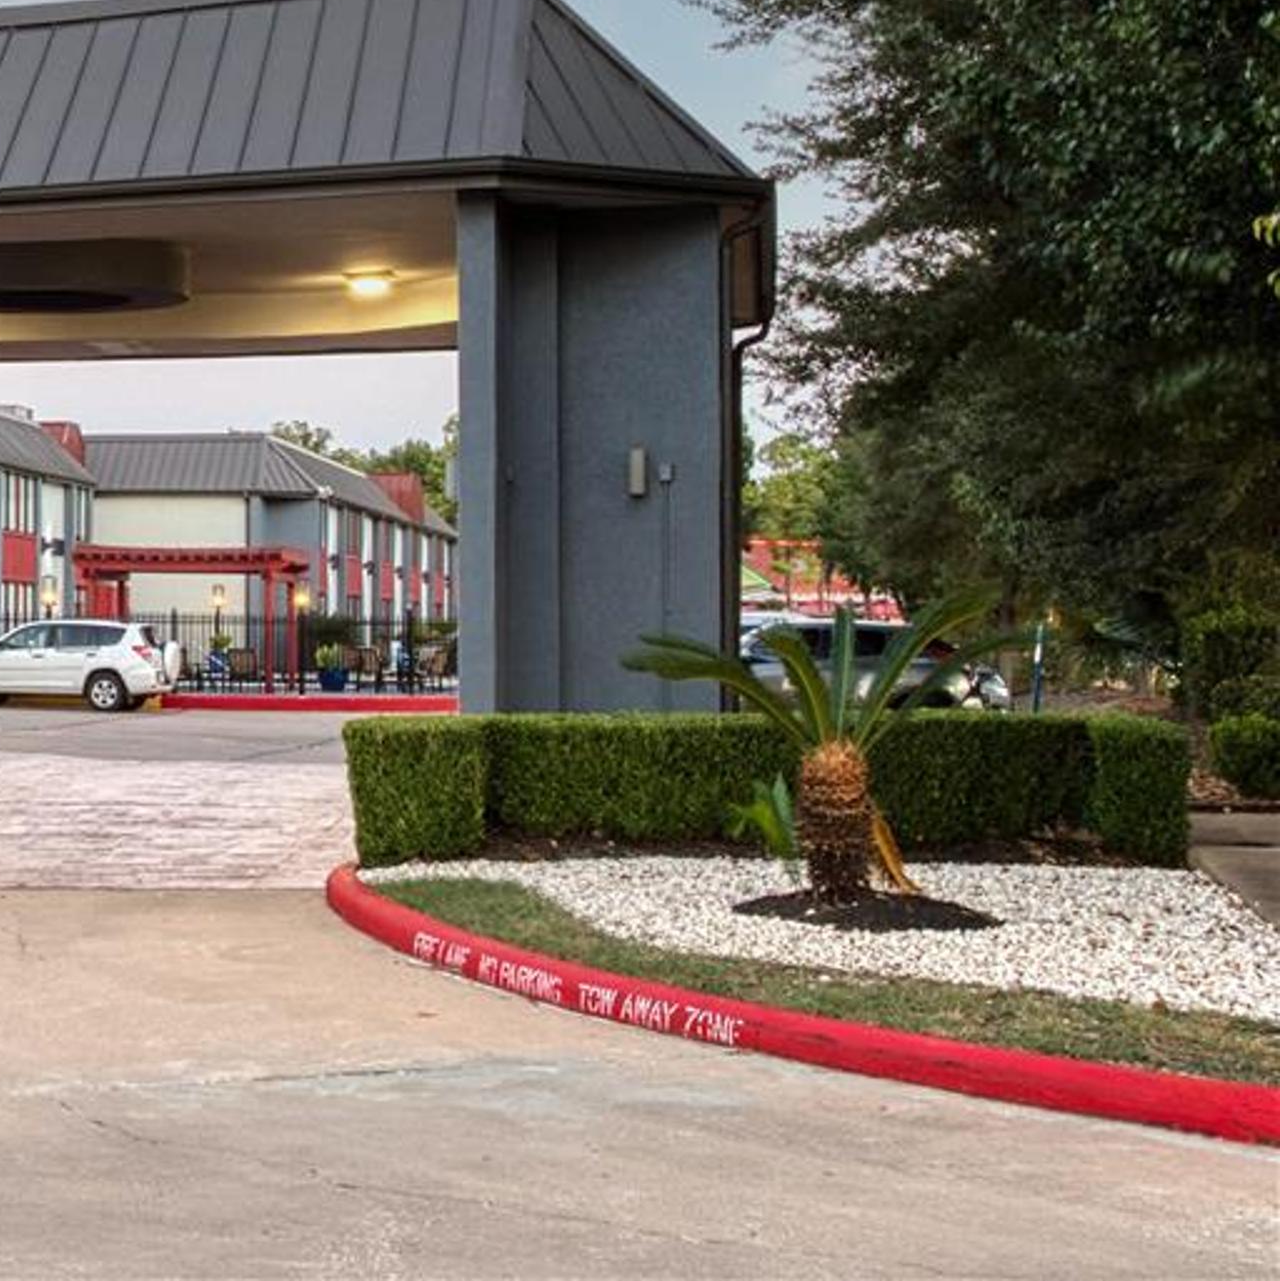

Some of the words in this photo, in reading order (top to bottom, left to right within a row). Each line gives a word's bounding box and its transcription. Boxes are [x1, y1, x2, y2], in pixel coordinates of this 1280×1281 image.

[499, 960, 563, 1002] PARKING
[578, 983, 618, 1017] TOW
[619, 992, 680, 1032] AWAY
